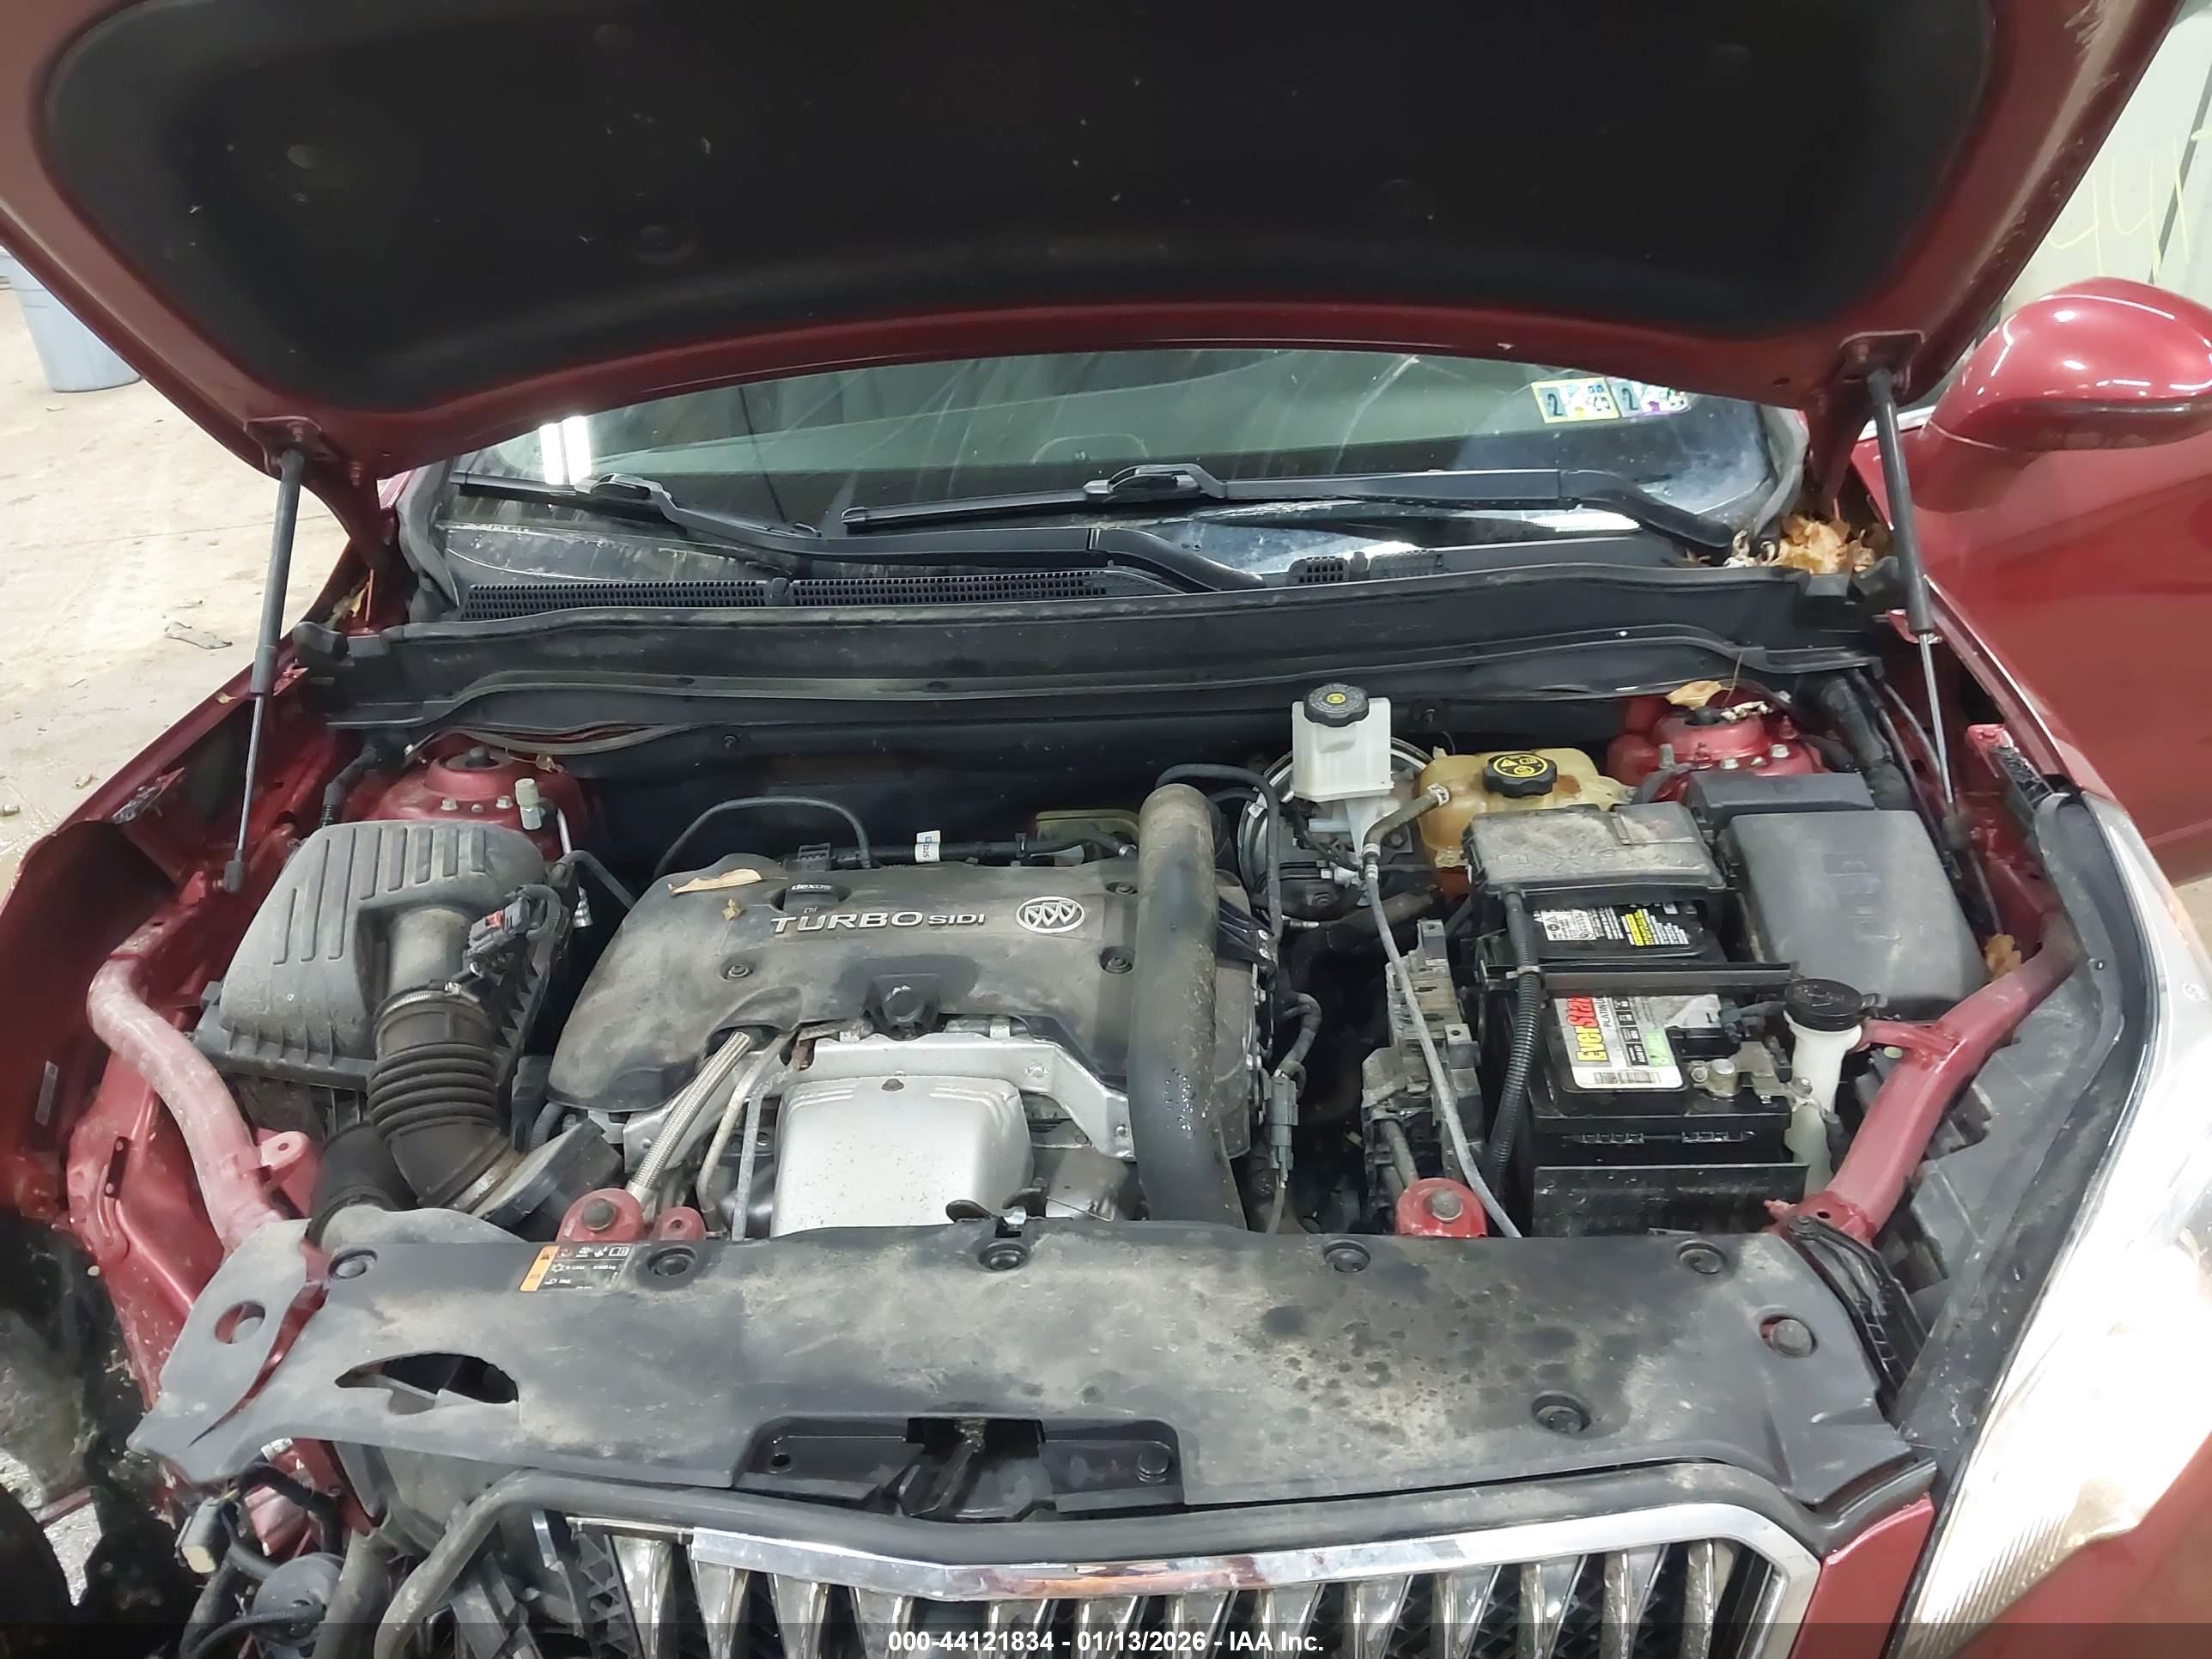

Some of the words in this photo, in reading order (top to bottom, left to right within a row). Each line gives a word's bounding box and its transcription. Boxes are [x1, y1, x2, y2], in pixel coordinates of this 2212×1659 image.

[1547, 393, 1564, 416] 2
[1621, 387, 1639, 411] 2
[771, 912, 924, 934] TURBO
[927, 913, 986, 927] SIDI
[1595, 997, 1612, 1028] PLATINU
